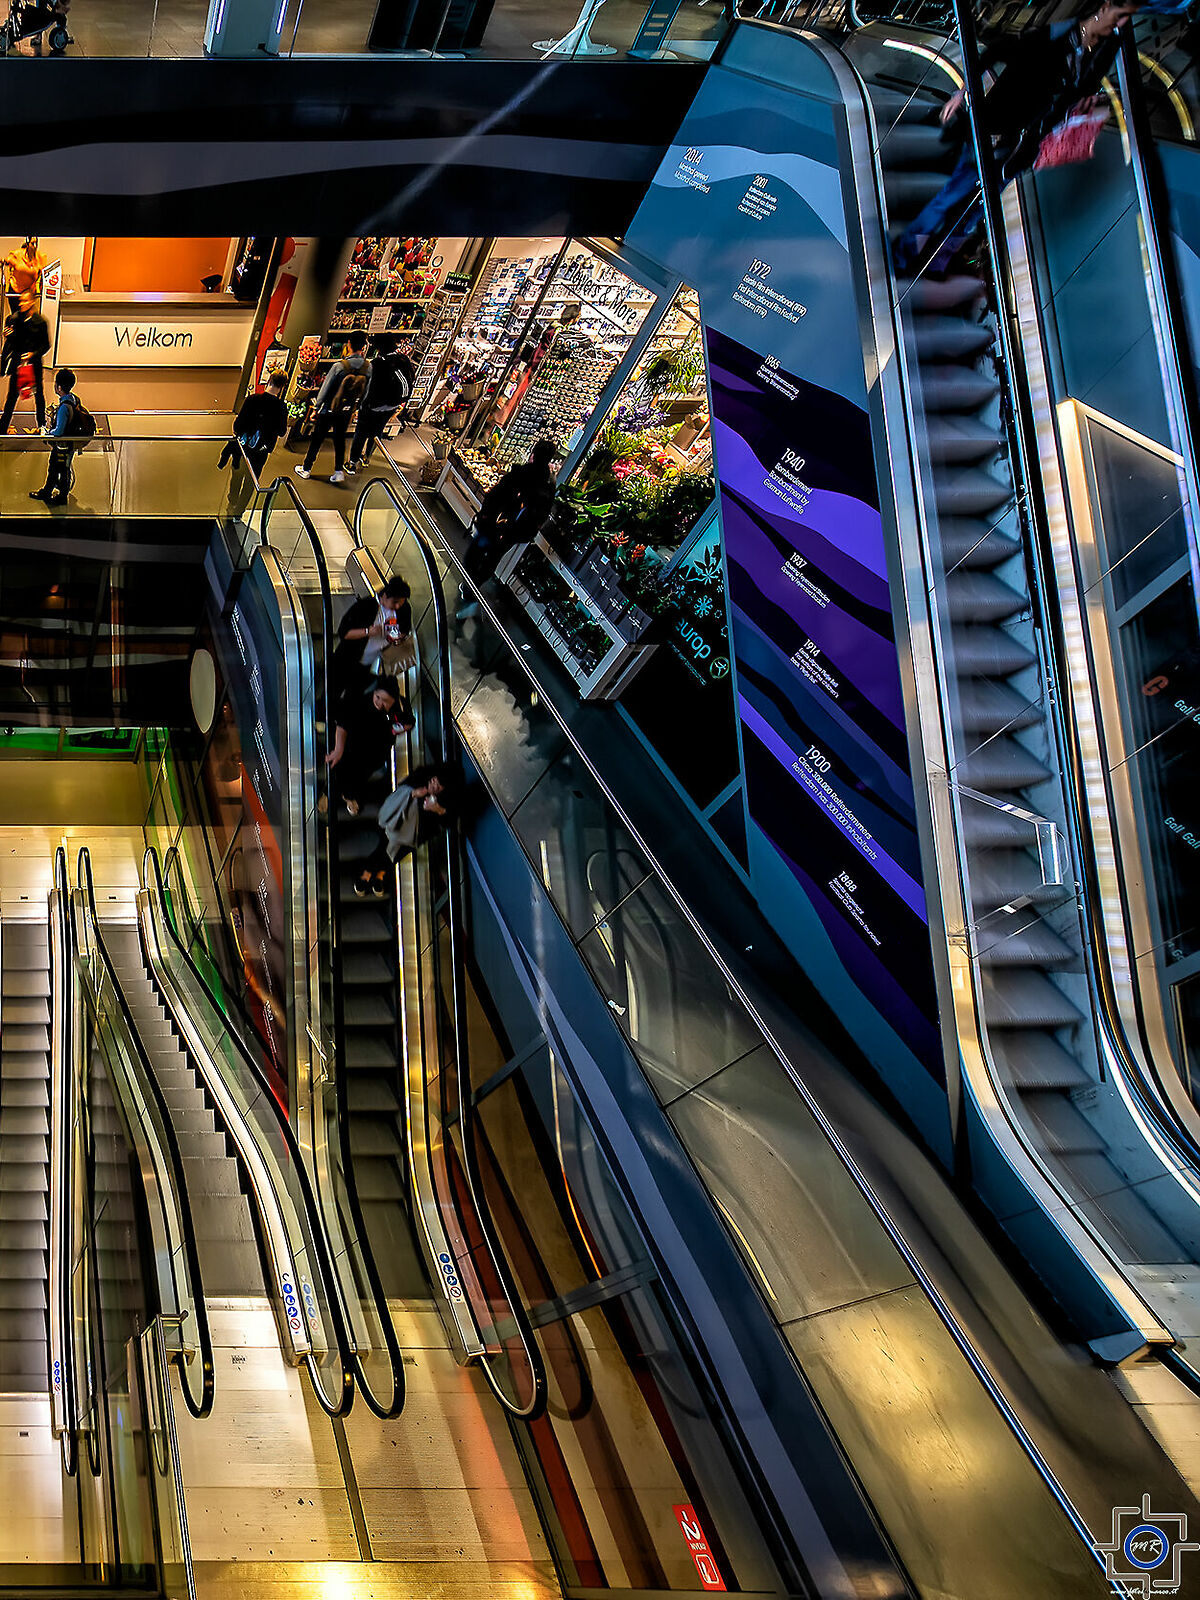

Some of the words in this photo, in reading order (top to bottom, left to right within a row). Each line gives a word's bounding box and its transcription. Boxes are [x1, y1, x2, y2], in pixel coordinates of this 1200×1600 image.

[683, 146, 704, 166] 2014
[748, 257, 772, 280] 1972
[598, 286, 612, 306] &
[608, 288, 637, 325] More
[114, 326, 193, 348] Welkom
[764, 354, 781, 370] 1965
[780, 447, 806, 472] 1940
[762, 478, 784, 498] German
[768, 469, 804, 501] Bombardment
[774, 462, 814, 495] Bombardement
[789, 551, 808, 569] 1937
[803, 638, 821, 657] 1914
[805, 744, 832, 774] 1900
[798, 755, 814, 775] Circa
[811, 771, 834, 796] 300.000
[829, 791, 873, 841] Rotterdammers
[791, 761, 819, 795] Rotterdam
[826, 801, 849, 827] 300.000
[845, 823, 878, 861] inhabitants
[1164, 815, 1186, 835] Gall
[838, 870, 858, 893] 1888
[680, 1510, 701, 1541] -2
